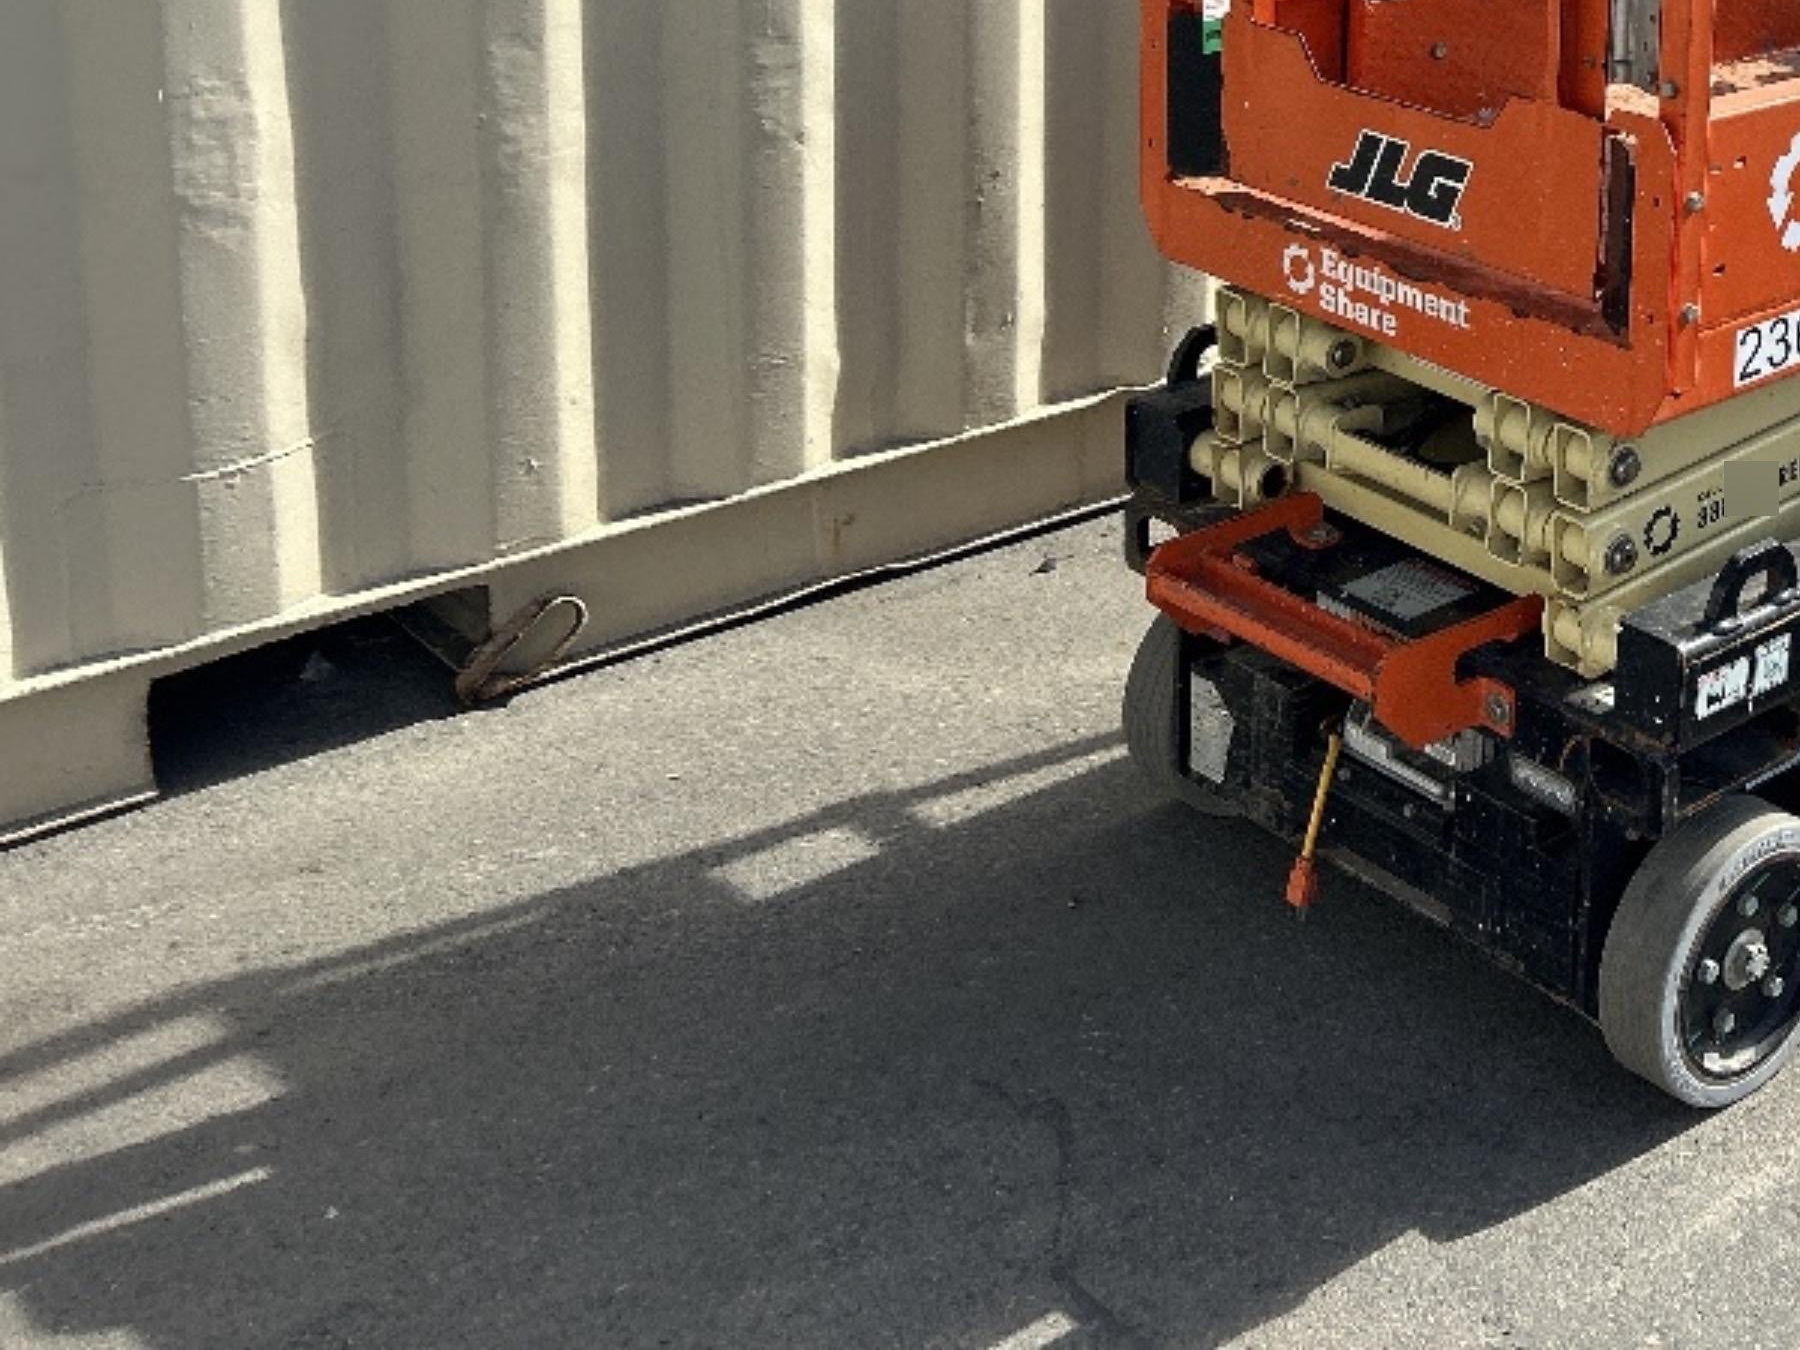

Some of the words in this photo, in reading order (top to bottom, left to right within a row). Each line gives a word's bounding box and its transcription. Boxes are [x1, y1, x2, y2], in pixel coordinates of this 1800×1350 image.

[1327, 128, 1475, 229] JLG
[1318, 248, 1471, 331] Equipment
[1318, 283, 1398, 337] Share
